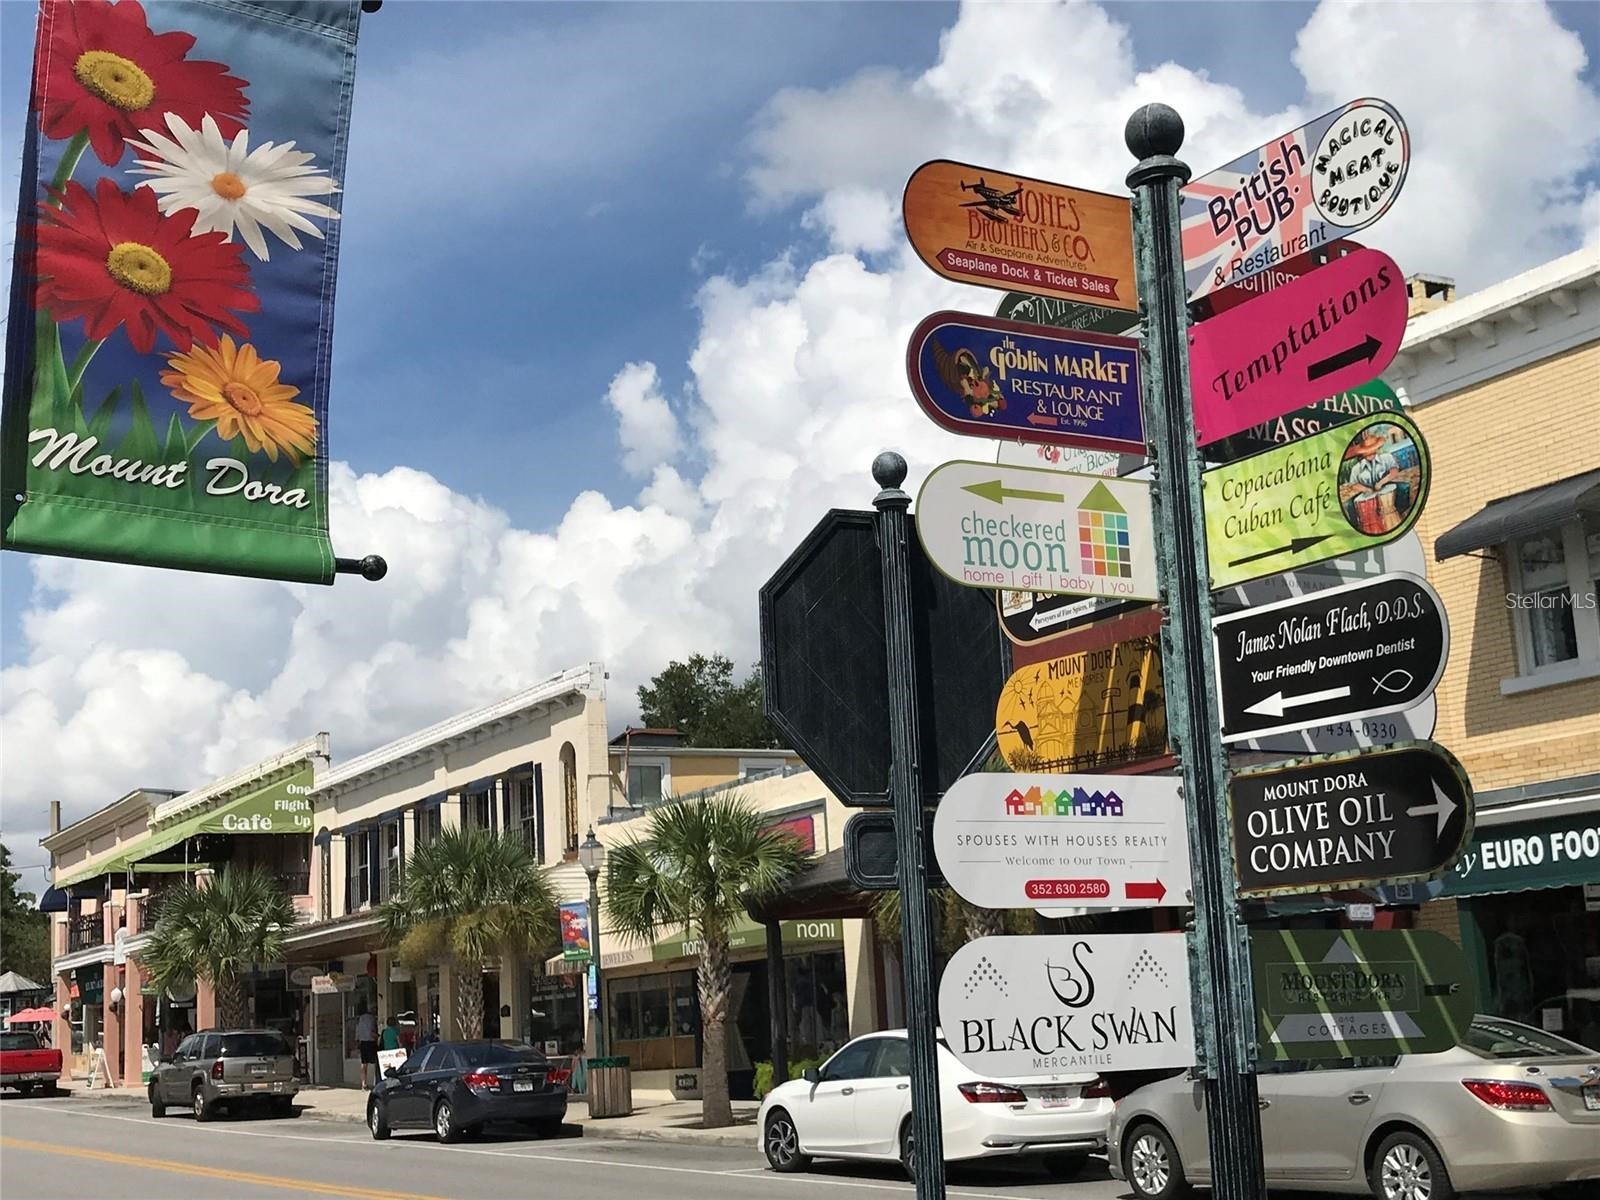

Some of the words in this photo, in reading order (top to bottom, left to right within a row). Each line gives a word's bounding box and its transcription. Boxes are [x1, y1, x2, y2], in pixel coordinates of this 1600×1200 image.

[1315, 118, 1394, 175] MAGICAL
[1329, 148, 1385, 188] MEAT
[1013, 181, 1081, 232] JONES
[1207, 140, 1305, 236] British
[1319, 161, 1399, 217] BOUTIQUE
[967, 208, 1049, 253] BROTHERS
[1051, 233, 1060, 252] &
[947, 252, 997, 273] Seaplane
[1002, 264, 1029, 280] Dock
[1033, 269, 1042, 282] &
[1045, 271, 1078, 288] Ticket
[1081, 278, 1110, 294] Sales
[965, 240, 977, 249] Air
[980, 243, 987, 252] &
[990, 244, 1033, 260] Seaplane
[1036, 253, 1088, 271] Adventures
[1214, 266, 1226, 286] &
[1231, 222, 1327, 280] Restaurant
[1211, 265, 1392, 401] Temptations
[990, 346, 1048, 380] Goblin
[1054, 350, 1130, 384] MARKET
[1012, 378, 1123, 407] RESTAURANT
[1037, 399, 1047, 414] &
[1052, 401, 1105, 421] LOUNGE
[1323, 391, 1394, 416] HANDS
[28, 428, 188, 488] Mount
[206, 458, 310, 508] Dora
[1221, 451, 1332, 509] Copacabana
[960, 510, 1066, 543] checkered
[1224, 501, 1283, 539] Cuban
[1289, 481, 1331, 527] Café
[962, 535, 1070, 573] moon
[963, 567, 1004, 584] home
[1022, 571, 1043, 588] gift
[1060, 575, 1094, 593] baby
[1110, 583, 1135, 594] you
[1236, 630, 1275, 662] James
[1278, 617, 1322, 650] Nolan
[1326, 601, 1372, 636] Flach,
[1375, 592, 1425, 625] D.D.S.
[1048, 654, 1089, 681] MOUNT
[1091, 647, 1123, 671] DORA
[1251, 668, 1274, 684] Your
[1276, 658, 1317, 679] Friendly
[1319, 649, 1373, 670] Downtown
[1376, 637, 1416, 657] Dentist
[1263, 779, 1319, 801] MOUNT
[1323, 771, 1368, 794] DORA
[223, 813, 272, 831] Café
[275, 799, 311, 812] Flight
[294, 815, 311, 828] Up
[1247, 801, 1330, 838] OLIVE
[1339, 792, 1394, 826] OIL
[957, 834, 1017, 847] SPOUSES
[1025, 834, 1059, 847] WITH
[1067, 835, 1118, 847] HOUSES
[1125, 835, 1168, 847] REALTY
[1250, 829, 1396, 874] COMPANY
[1481, 835, 1544, 870] EURO
[1550, 828, 1600, 862] FOO
[1005, 856, 1056, 866] Welcome
[1059, 856, 1070, 866] to
[1073, 856, 1093, 866] Our
[1097, 856, 1126, 866] Town
[1031, 883, 1107, 895] 352.630.2580
[1353, 972, 1403, 990] DORA
[960, 1014, 1086, 1055] BLACK
[1091, 1006, 1178, 1052] SWAN
[1307, 1023, 1387, 1037] COTTAGES
[1032, 1053, 1113, 1069] MERCANTILE
